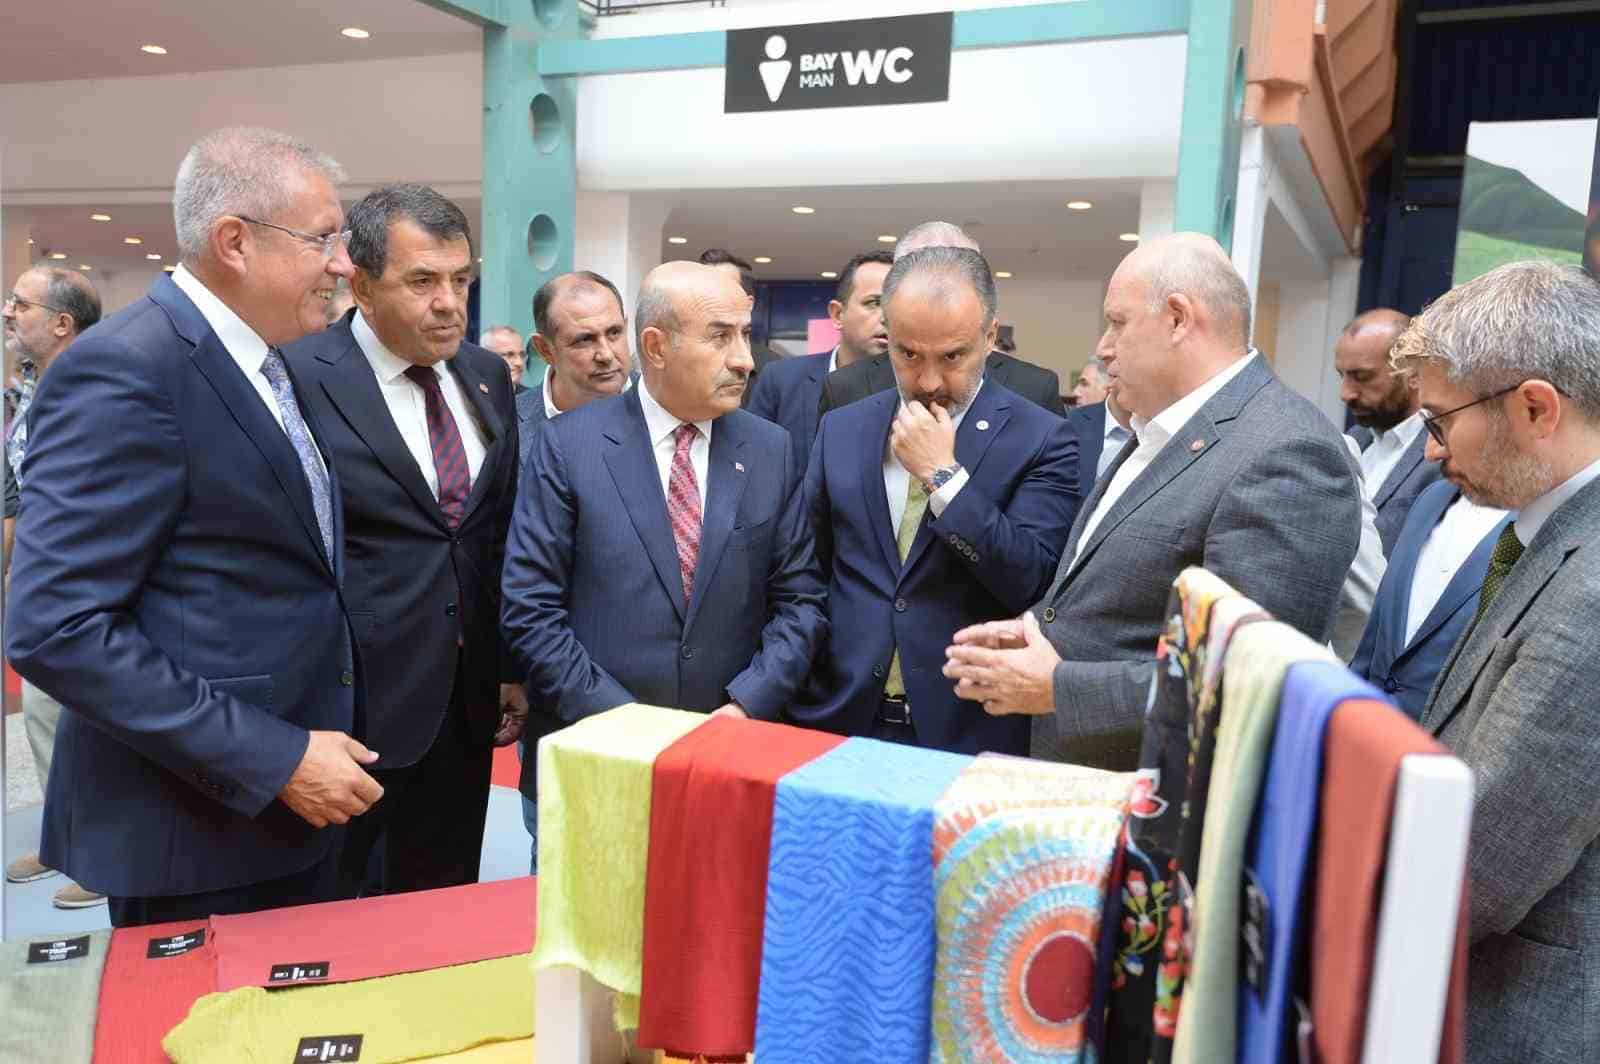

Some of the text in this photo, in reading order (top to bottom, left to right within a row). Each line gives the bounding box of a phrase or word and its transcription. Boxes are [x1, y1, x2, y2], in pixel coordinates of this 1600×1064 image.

[800, 53, 838, 72] BAY
[840, 47, 914, 85] WC
[800, 73, 834, 88] MAN
